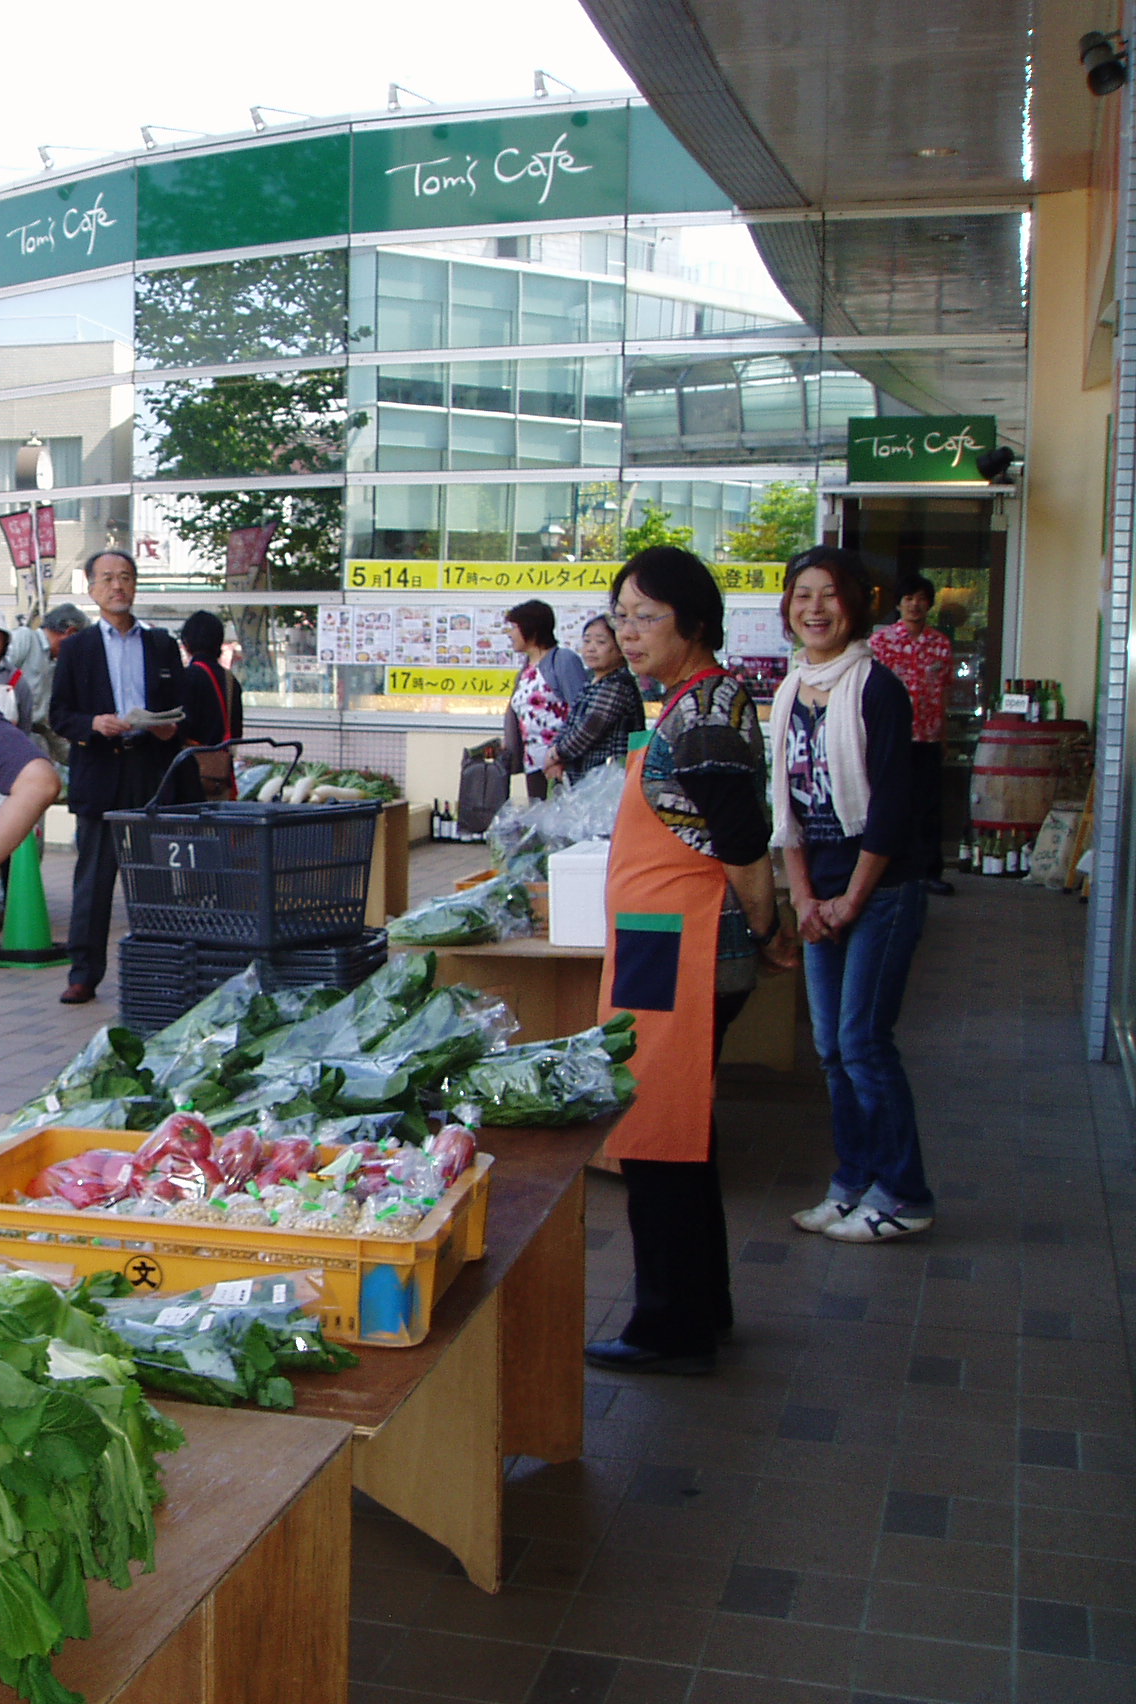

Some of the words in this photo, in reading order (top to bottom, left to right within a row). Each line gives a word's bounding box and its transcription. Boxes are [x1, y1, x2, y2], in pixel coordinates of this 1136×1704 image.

[351, 565, 422, 588] 5月14日
[168, 841, 196, 869] 21
[131, 1260, 157, 1289] 文
